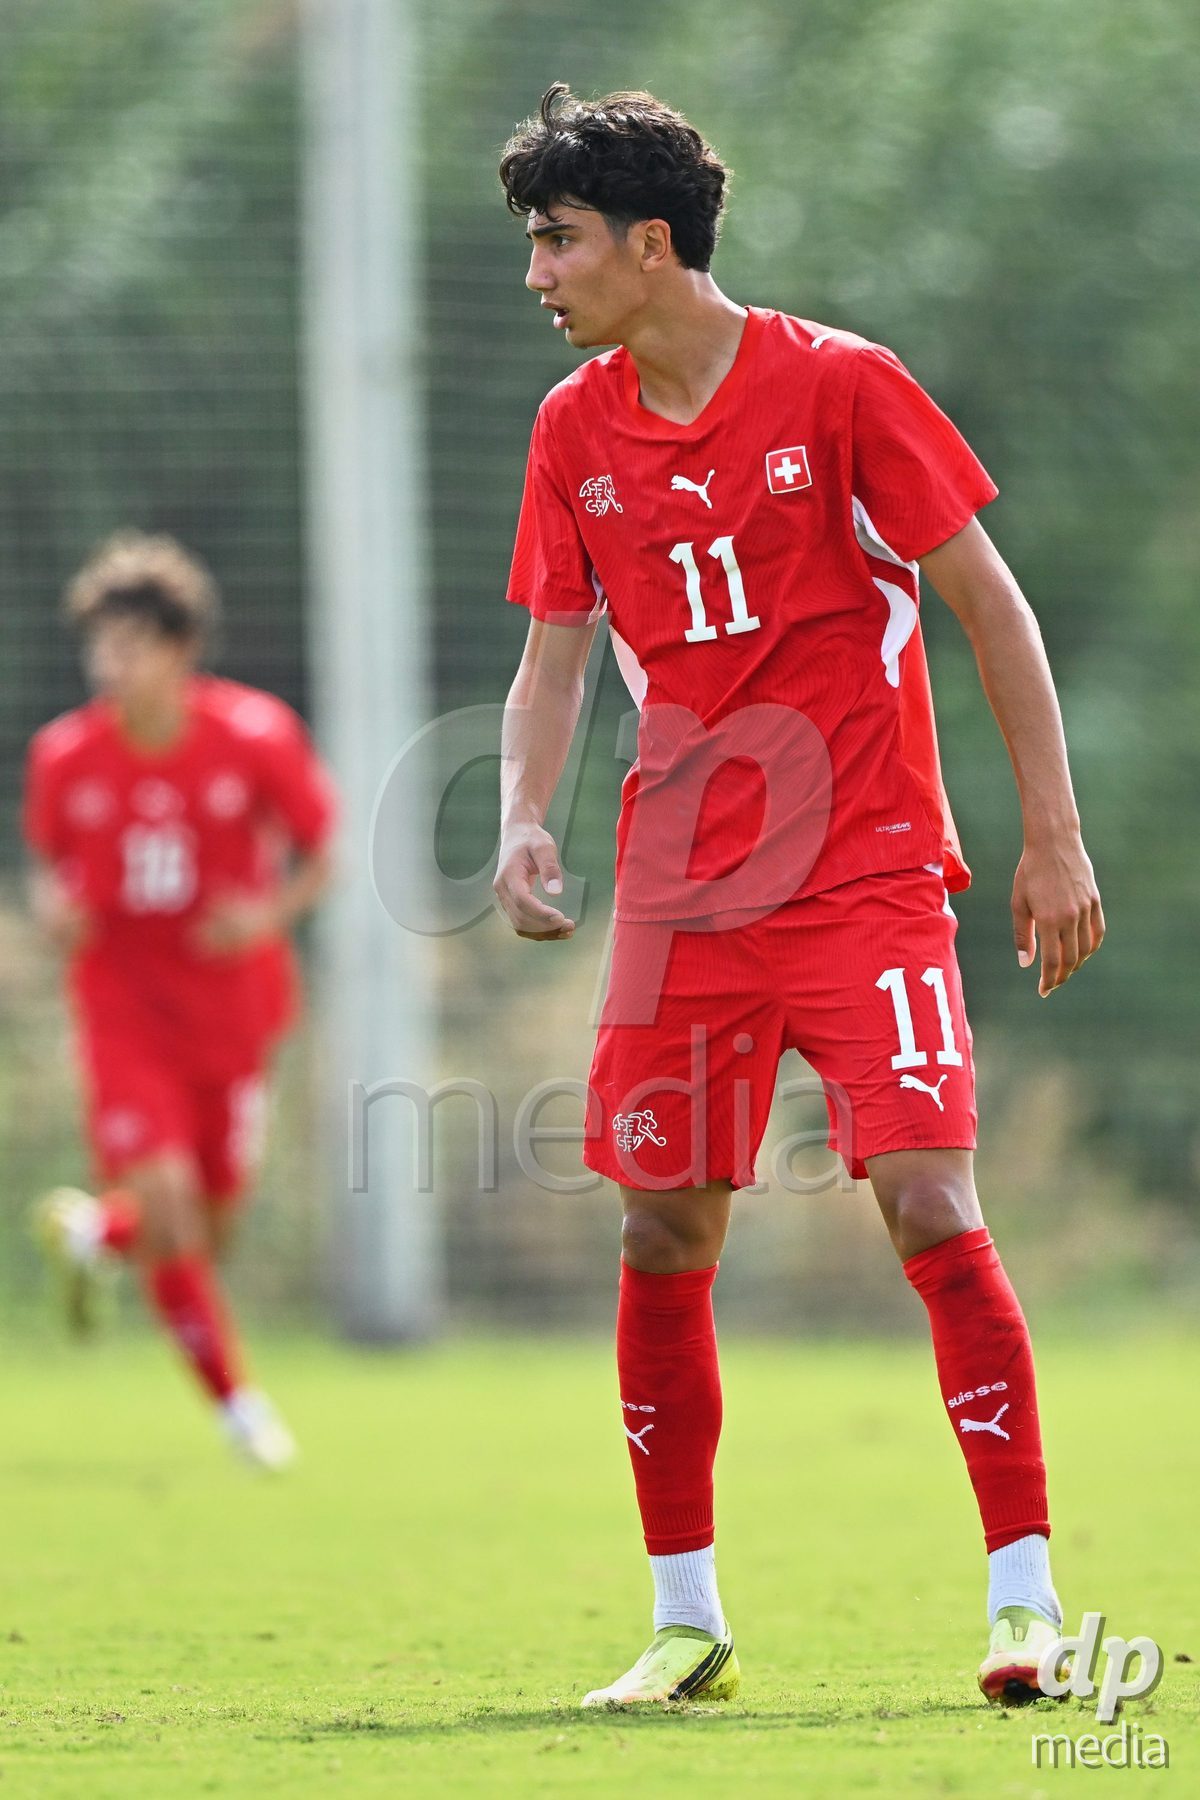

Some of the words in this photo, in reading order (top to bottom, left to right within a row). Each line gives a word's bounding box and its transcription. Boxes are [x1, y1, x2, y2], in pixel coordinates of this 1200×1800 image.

[668, 535, 761, 643] 11
[874, 967, 964, 1071] 11
[947, 1381, 1008, 1409] suisse
